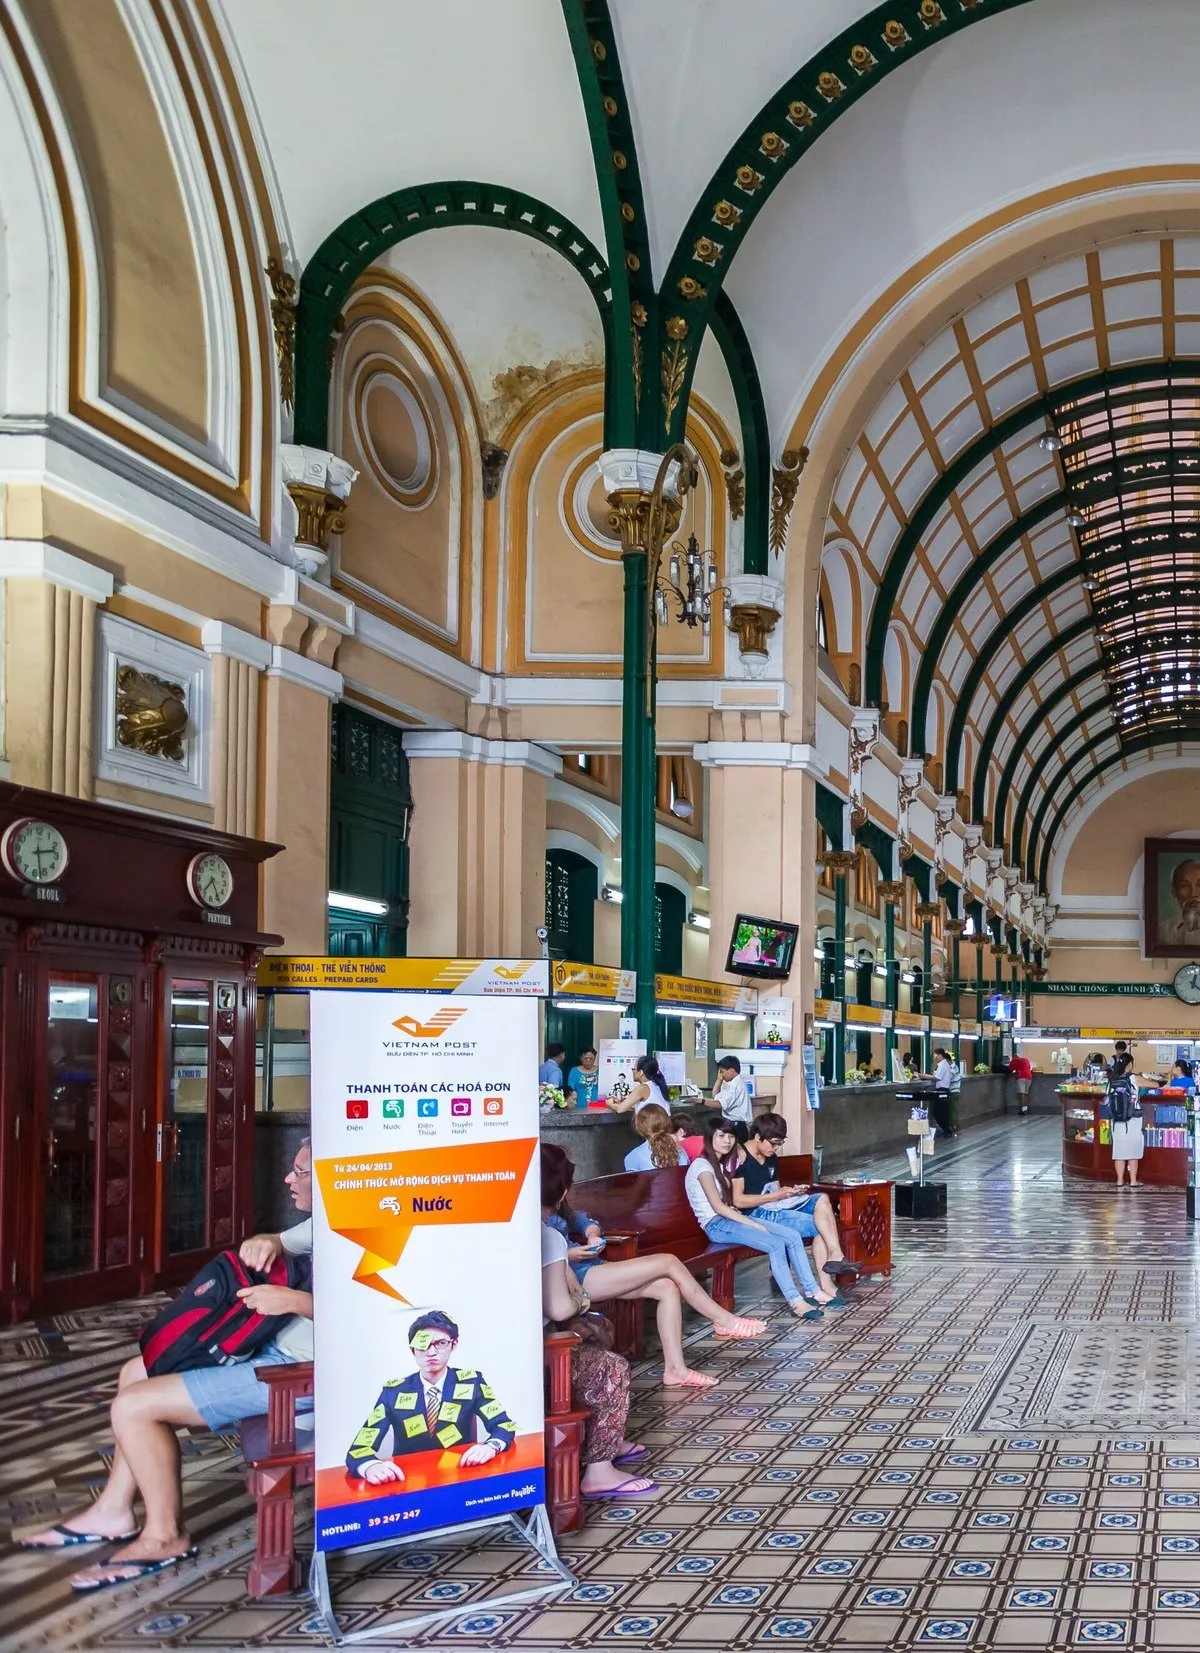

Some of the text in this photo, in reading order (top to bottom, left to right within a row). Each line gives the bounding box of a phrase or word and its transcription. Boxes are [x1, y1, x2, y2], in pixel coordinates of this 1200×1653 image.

[24, 864, 29, 872] 7
[32, 869, 38, 877] 6
[37, 888, 60, 900] SEOUL
[360, 962, 386, 973] THÔNG
[1118, 984, 1146, 992] CHÍNH
[220, 988, 232, 1008] 7
[346, 1082, 510, 1094] THANH TOÁN CÁC HOÁ ĐƠN
[334, 1163, 392, 1172] Từ 24/04/2013
[334, 1170, 516, 1190] CHÍNH THỨC MỞ RỘNG DỊCH VỤ THANH TOÁN
[412, 1196, 452, 1212] Nước
[511, 1486, 534, 1498] Payoo
[322, 1509, 420, 1536] HOTLINE: 39 247 247
